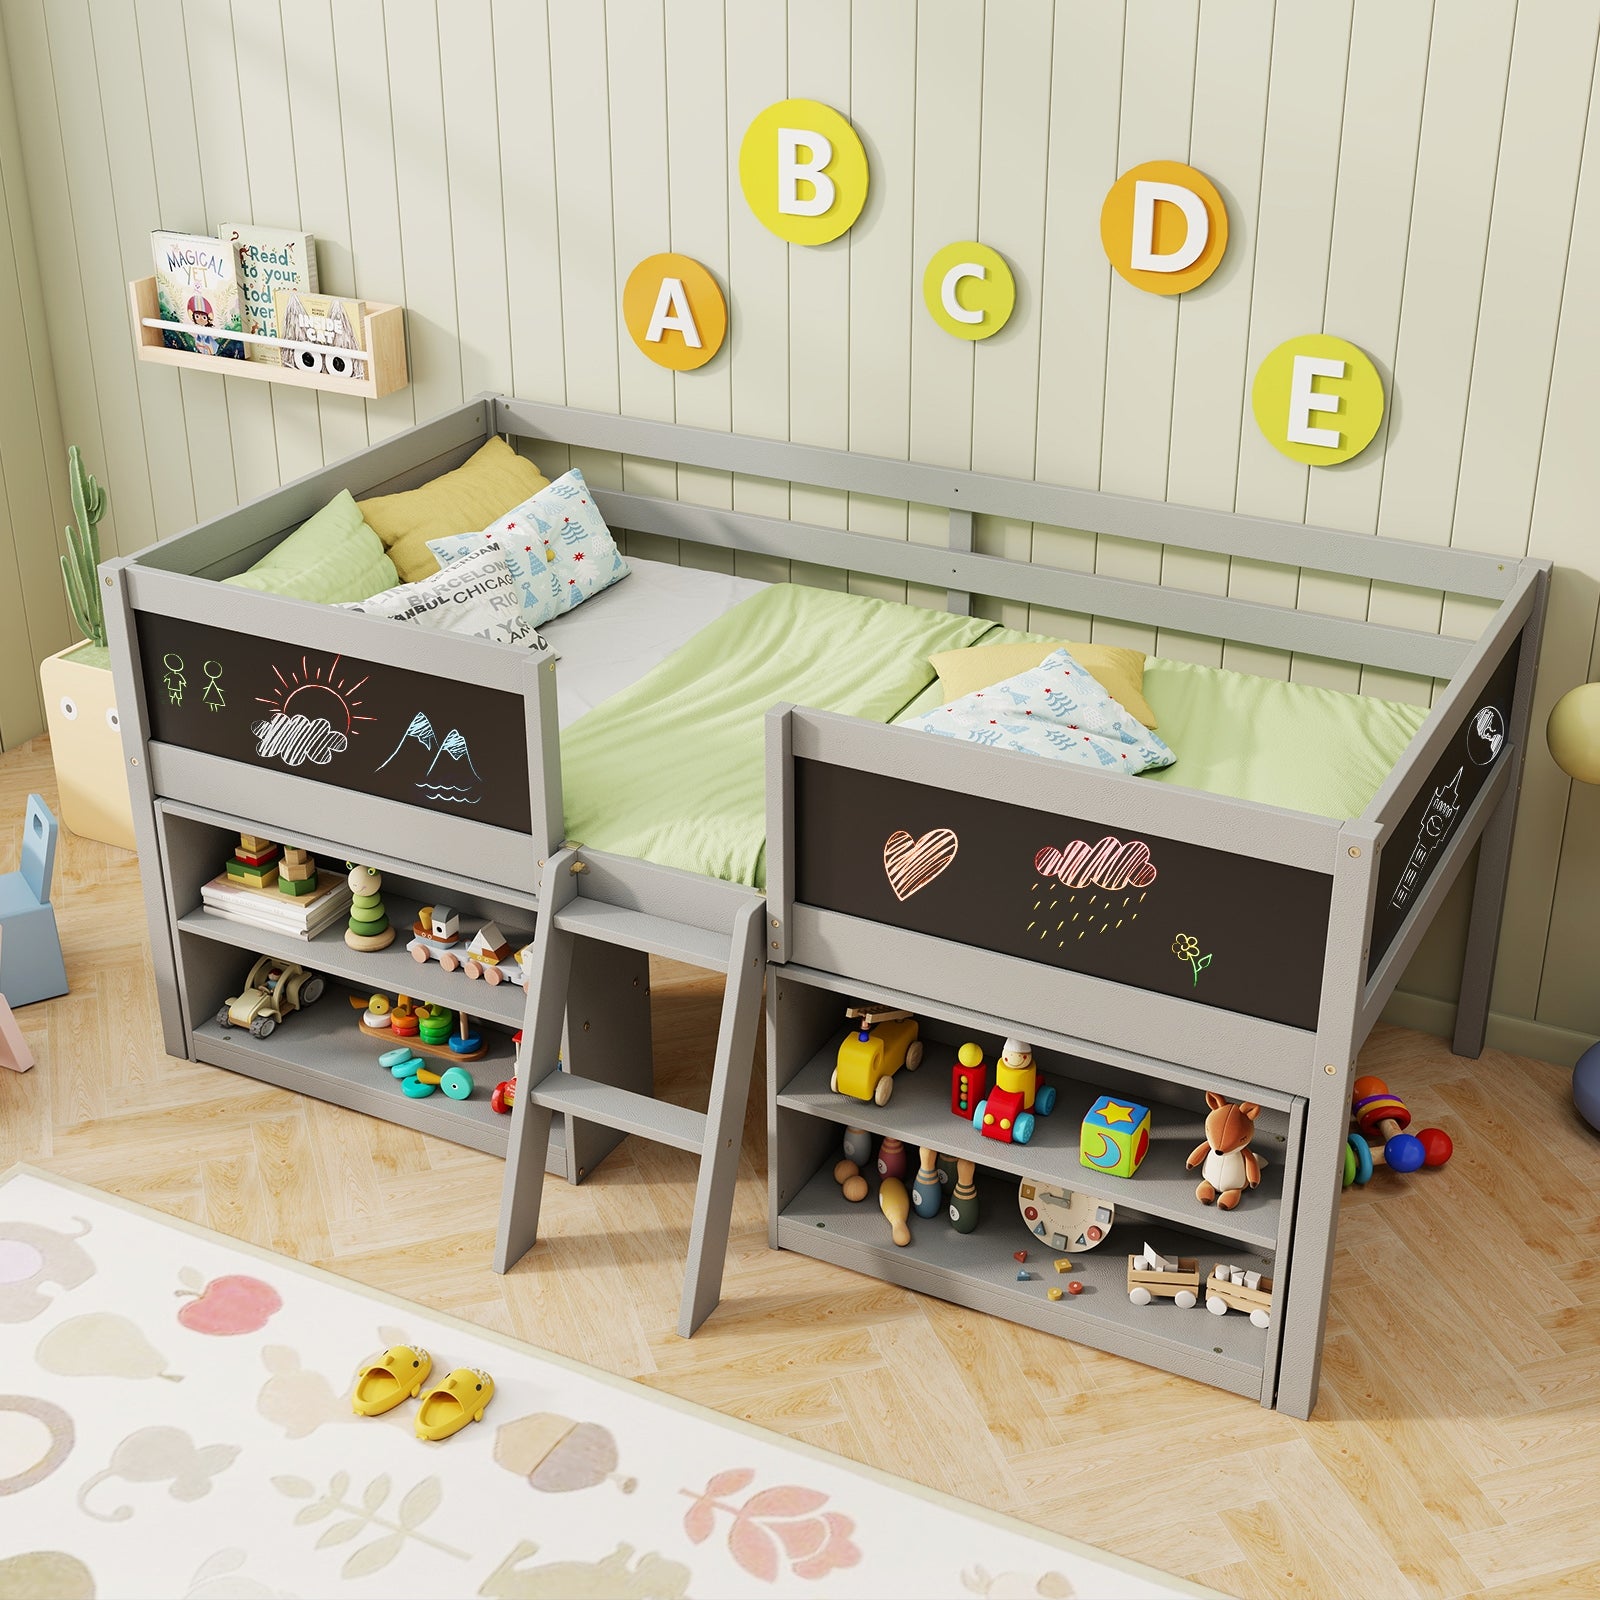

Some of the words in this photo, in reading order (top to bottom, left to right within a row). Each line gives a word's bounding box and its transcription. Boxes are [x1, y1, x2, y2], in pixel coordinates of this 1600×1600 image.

[777, 127, 836, 217] B
[1131, 180, 1209, 273] D
[166, 249, 224, 278] MAGICAL
[249, 245, 289, 266] Read
[182, 266, 208, 289] YET
[241, 261, 259, 279] to
[263, 268, 297, 285] your
[242, 284, 273, 304] tod
[941, 263, 986, 325] C
[299, 314, 343, 335] INSIDE
[645, 277, 702, 349] A
[306, 327, 336, 346] CAT
[1287, 355, 1346, 449] E
[406, 560, 509, 607] BARCELON
[388, 596, 451, 621] ANBUL
